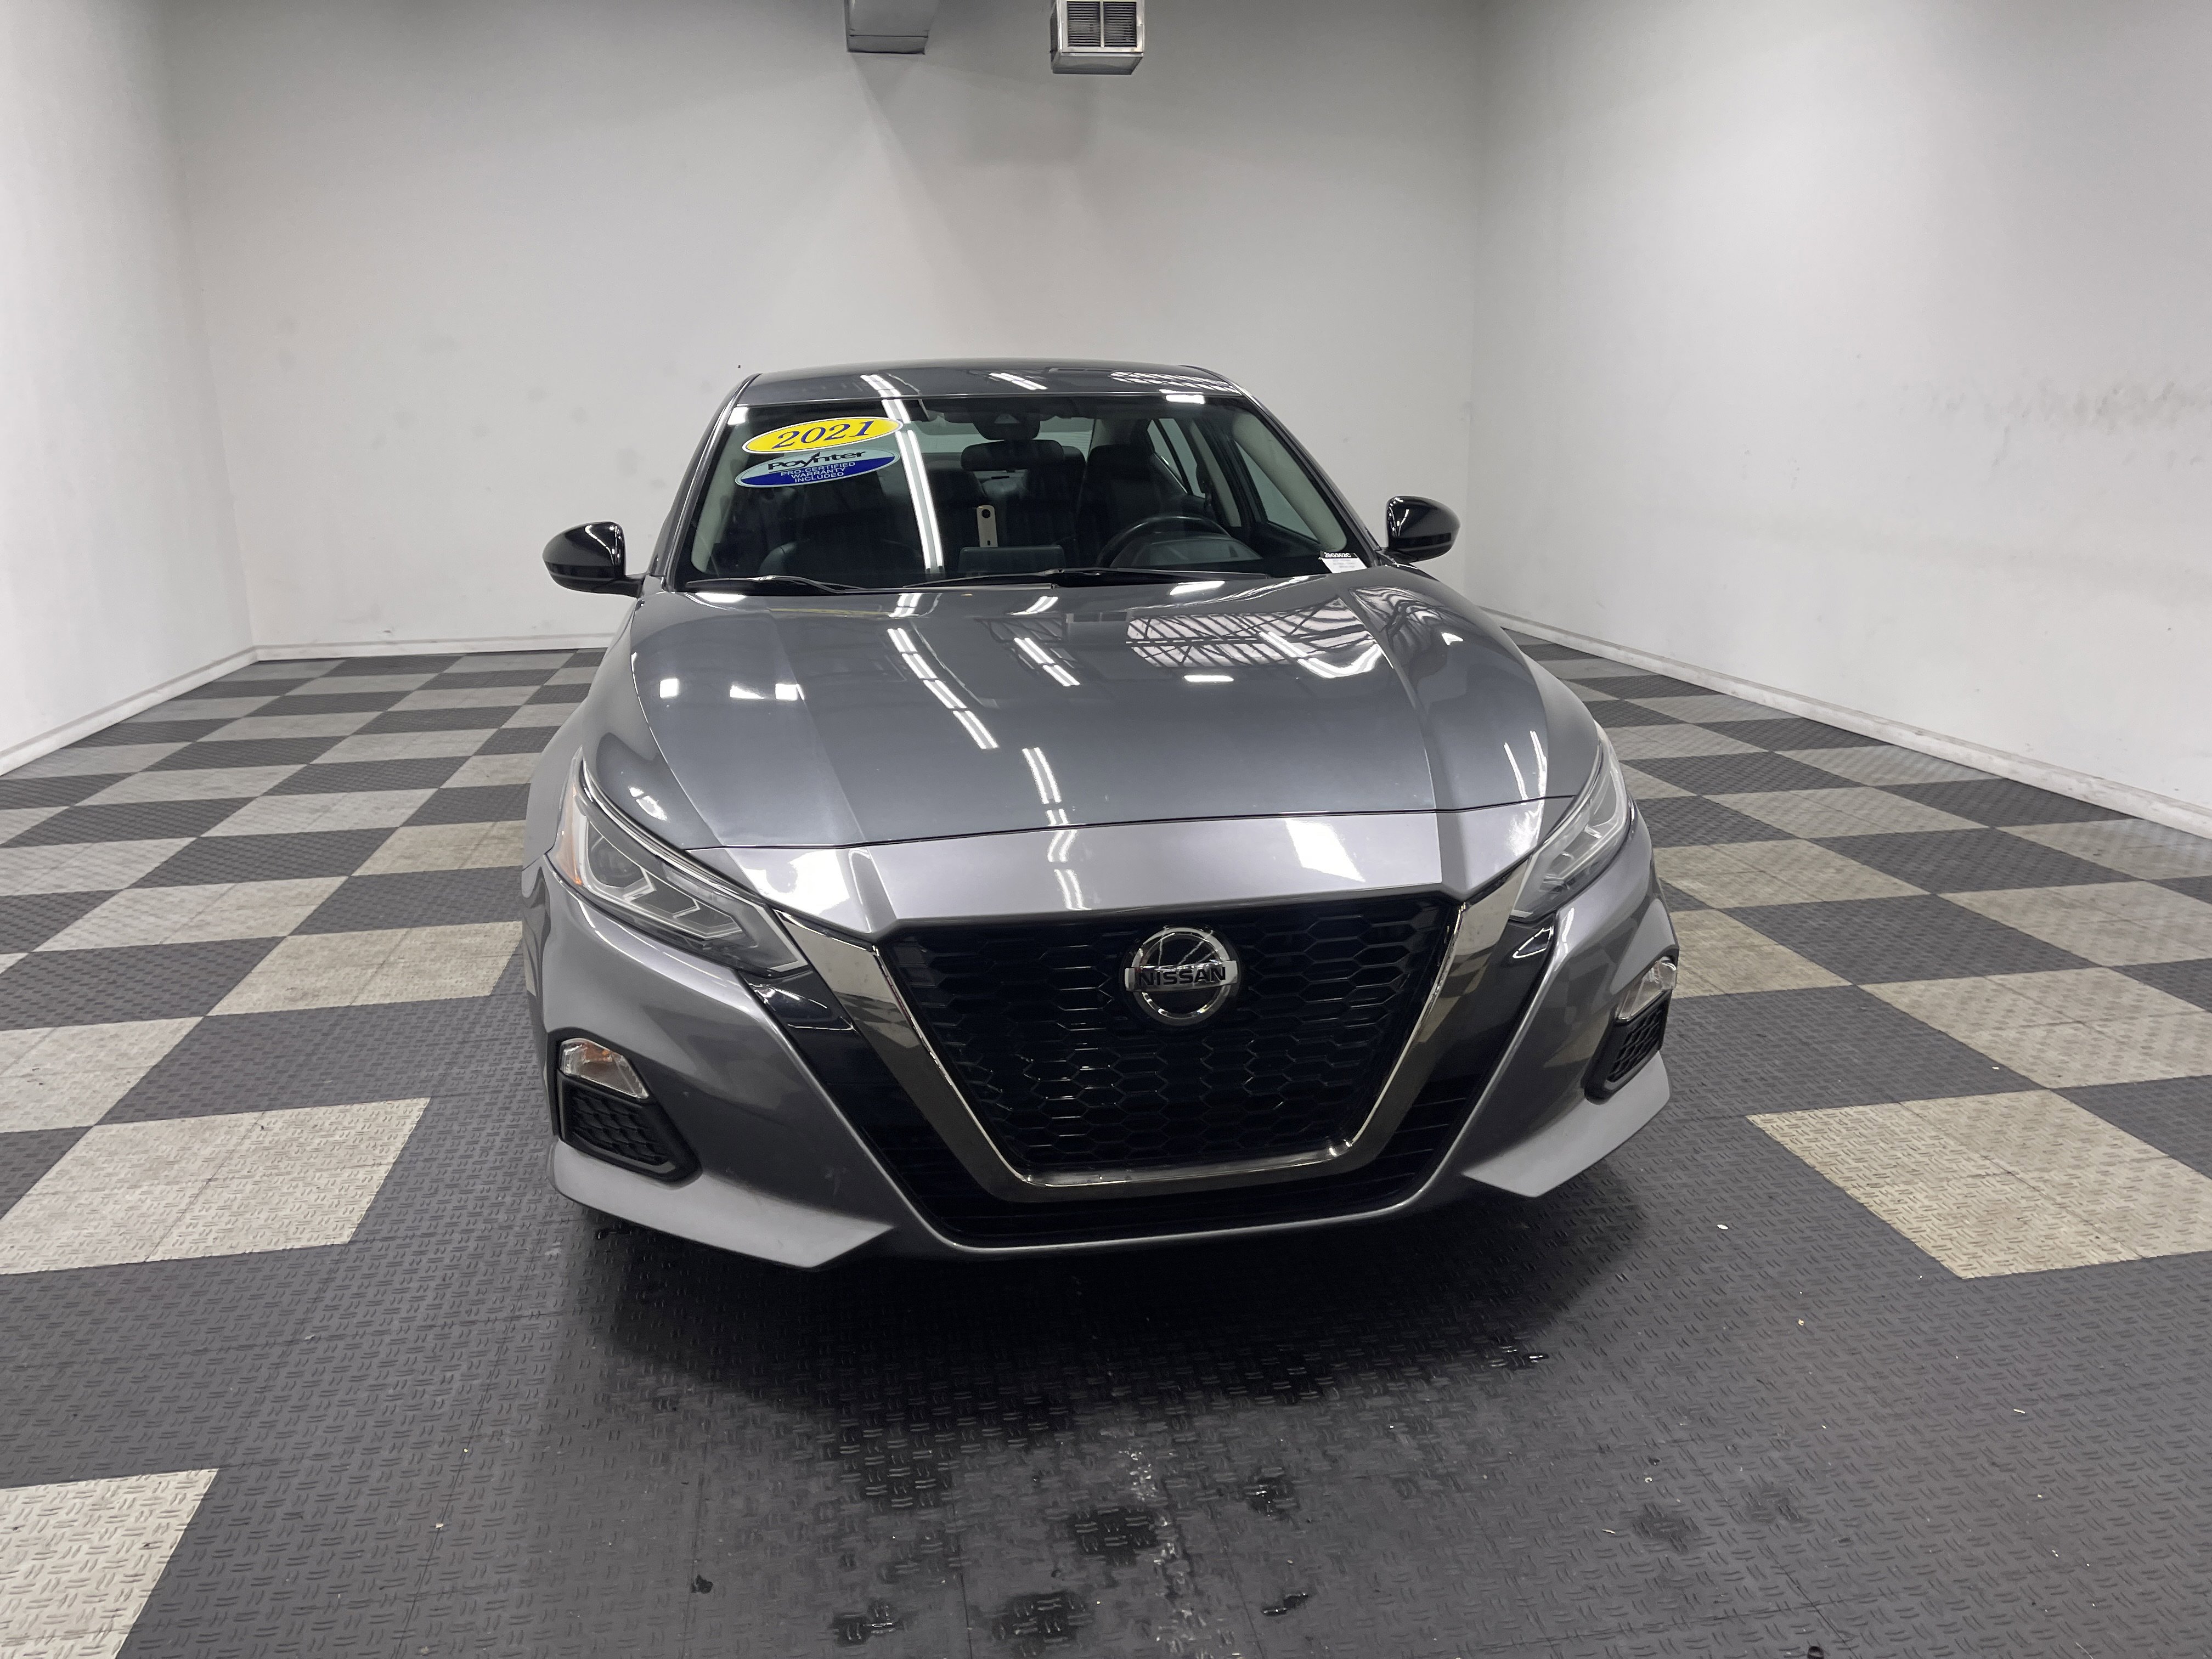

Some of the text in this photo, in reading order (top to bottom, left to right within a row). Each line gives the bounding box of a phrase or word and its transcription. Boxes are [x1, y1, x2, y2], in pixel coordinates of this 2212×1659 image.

[771, 420, 874, 450] 2021
[769, 452, 866, 470] Poynter
[781, 461, 855, 477] PRO-CERTIFIED
[791, 467, 845, 479] WARRANTY
[794, 471, 844, 483] INCLUDED
[1138, 967, 1226, 986] NISSAN
